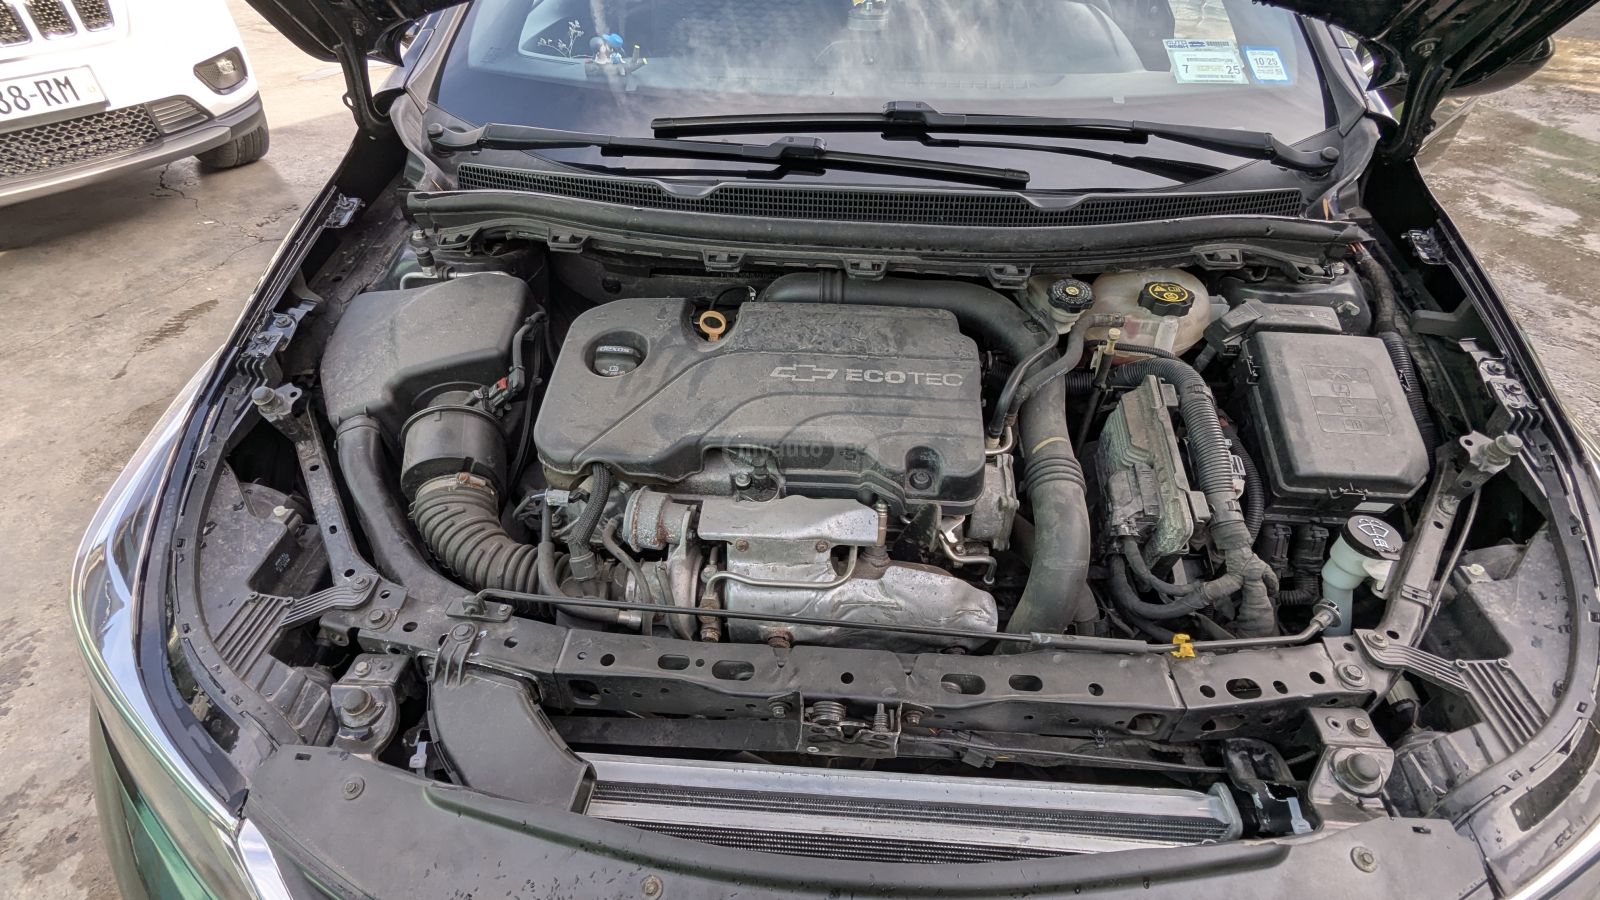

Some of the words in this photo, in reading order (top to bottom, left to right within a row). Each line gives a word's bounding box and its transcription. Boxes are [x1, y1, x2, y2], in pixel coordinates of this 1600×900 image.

[1182, 64, 1189, 73] 7
[1225, 65, 1241, 75] 25
[845, 368, 964, 387] ECOTEC
